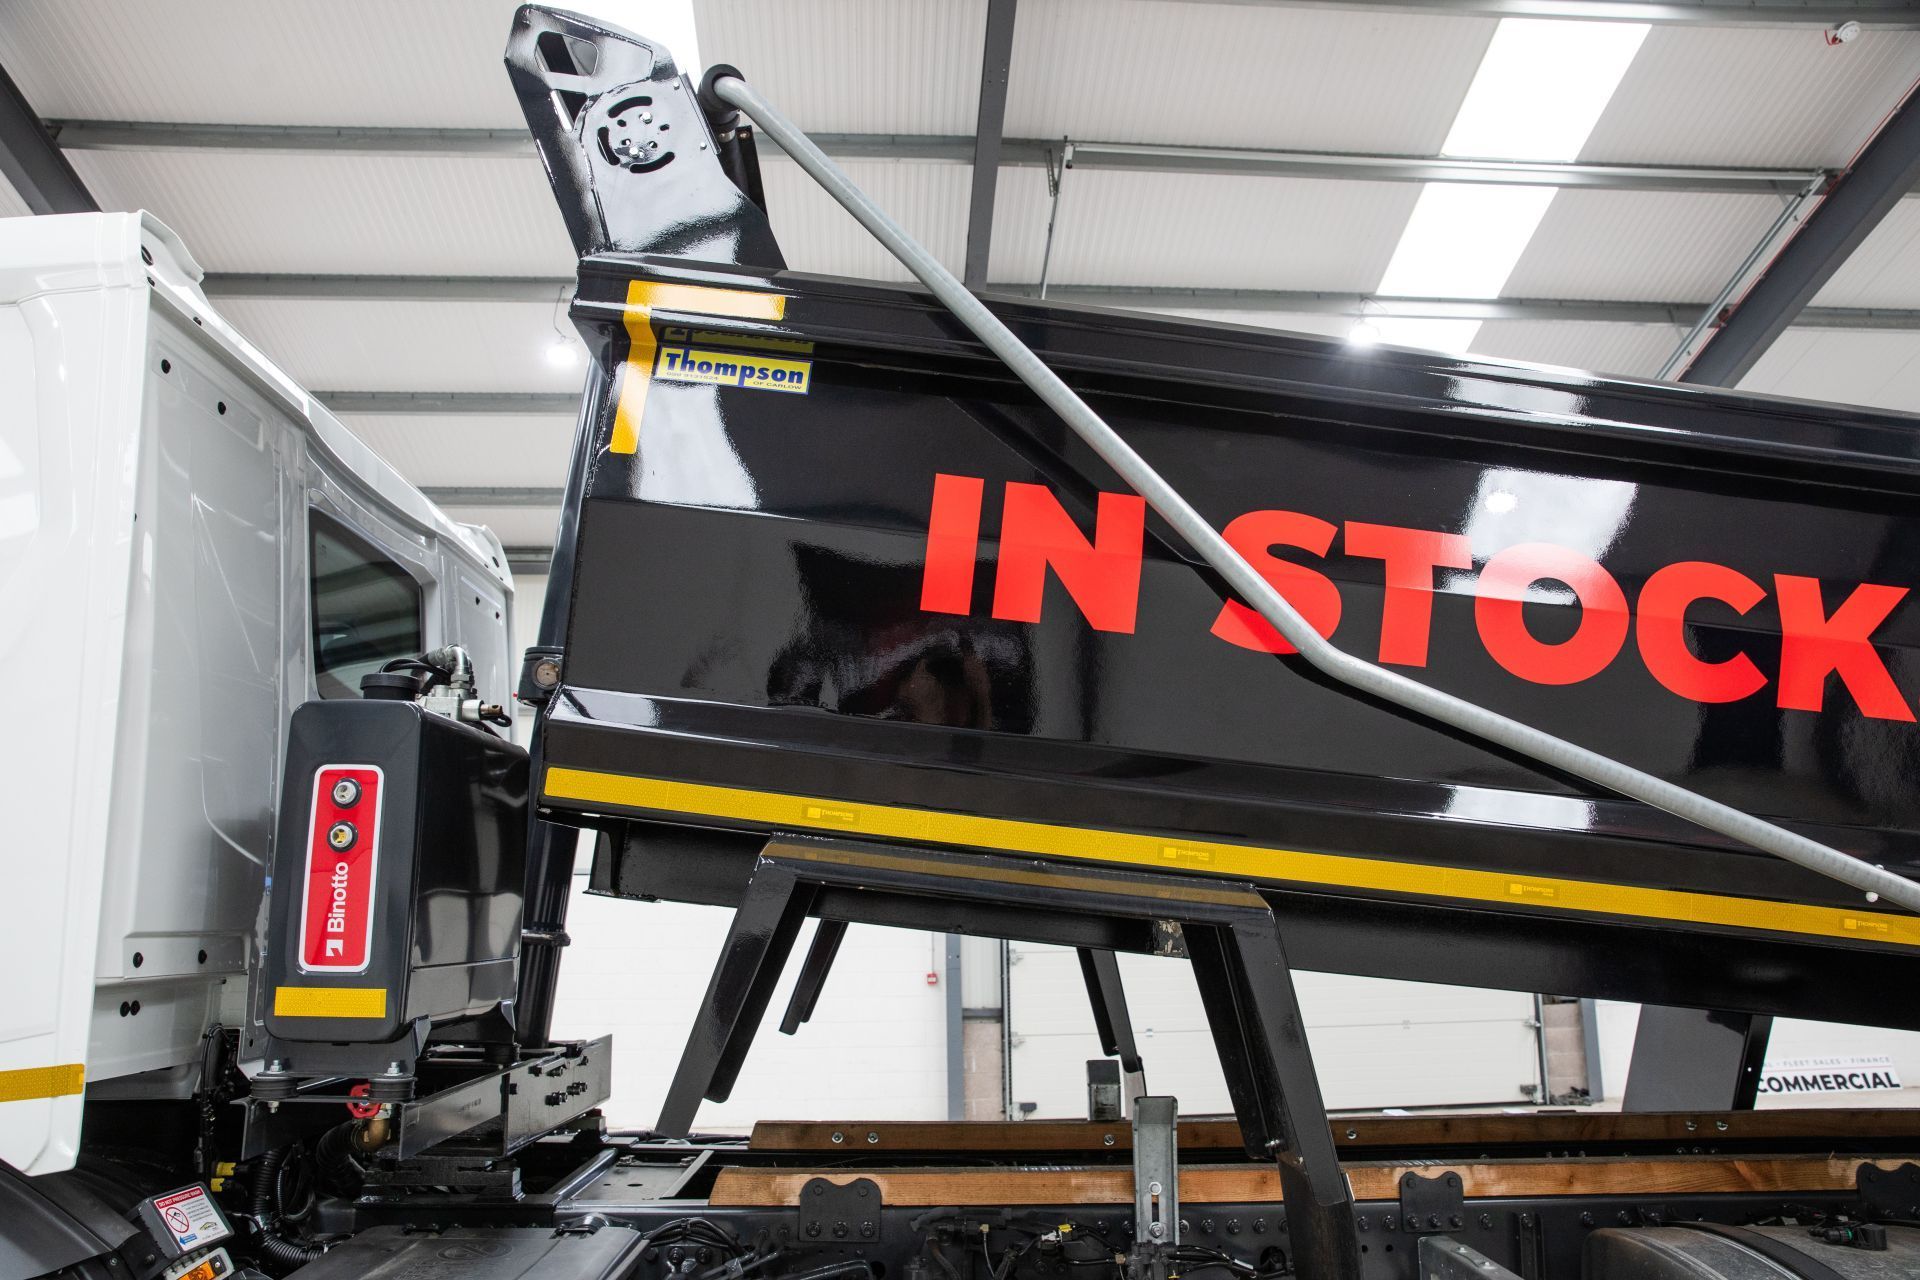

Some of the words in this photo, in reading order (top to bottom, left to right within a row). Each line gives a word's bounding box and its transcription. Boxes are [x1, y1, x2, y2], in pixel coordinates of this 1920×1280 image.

[666, 348, 804, 387] Thompson
[766, 382, 802, 390] CARLOW
[920, 473, 1146, 635] IN
[1209, 509, 1917, 723] STOCK
[327, 862, 349, 933] Binotto
[1814, 1058, 1841, 1066] SALES
[1851, 1056, 1890, 1064] FINANCE
